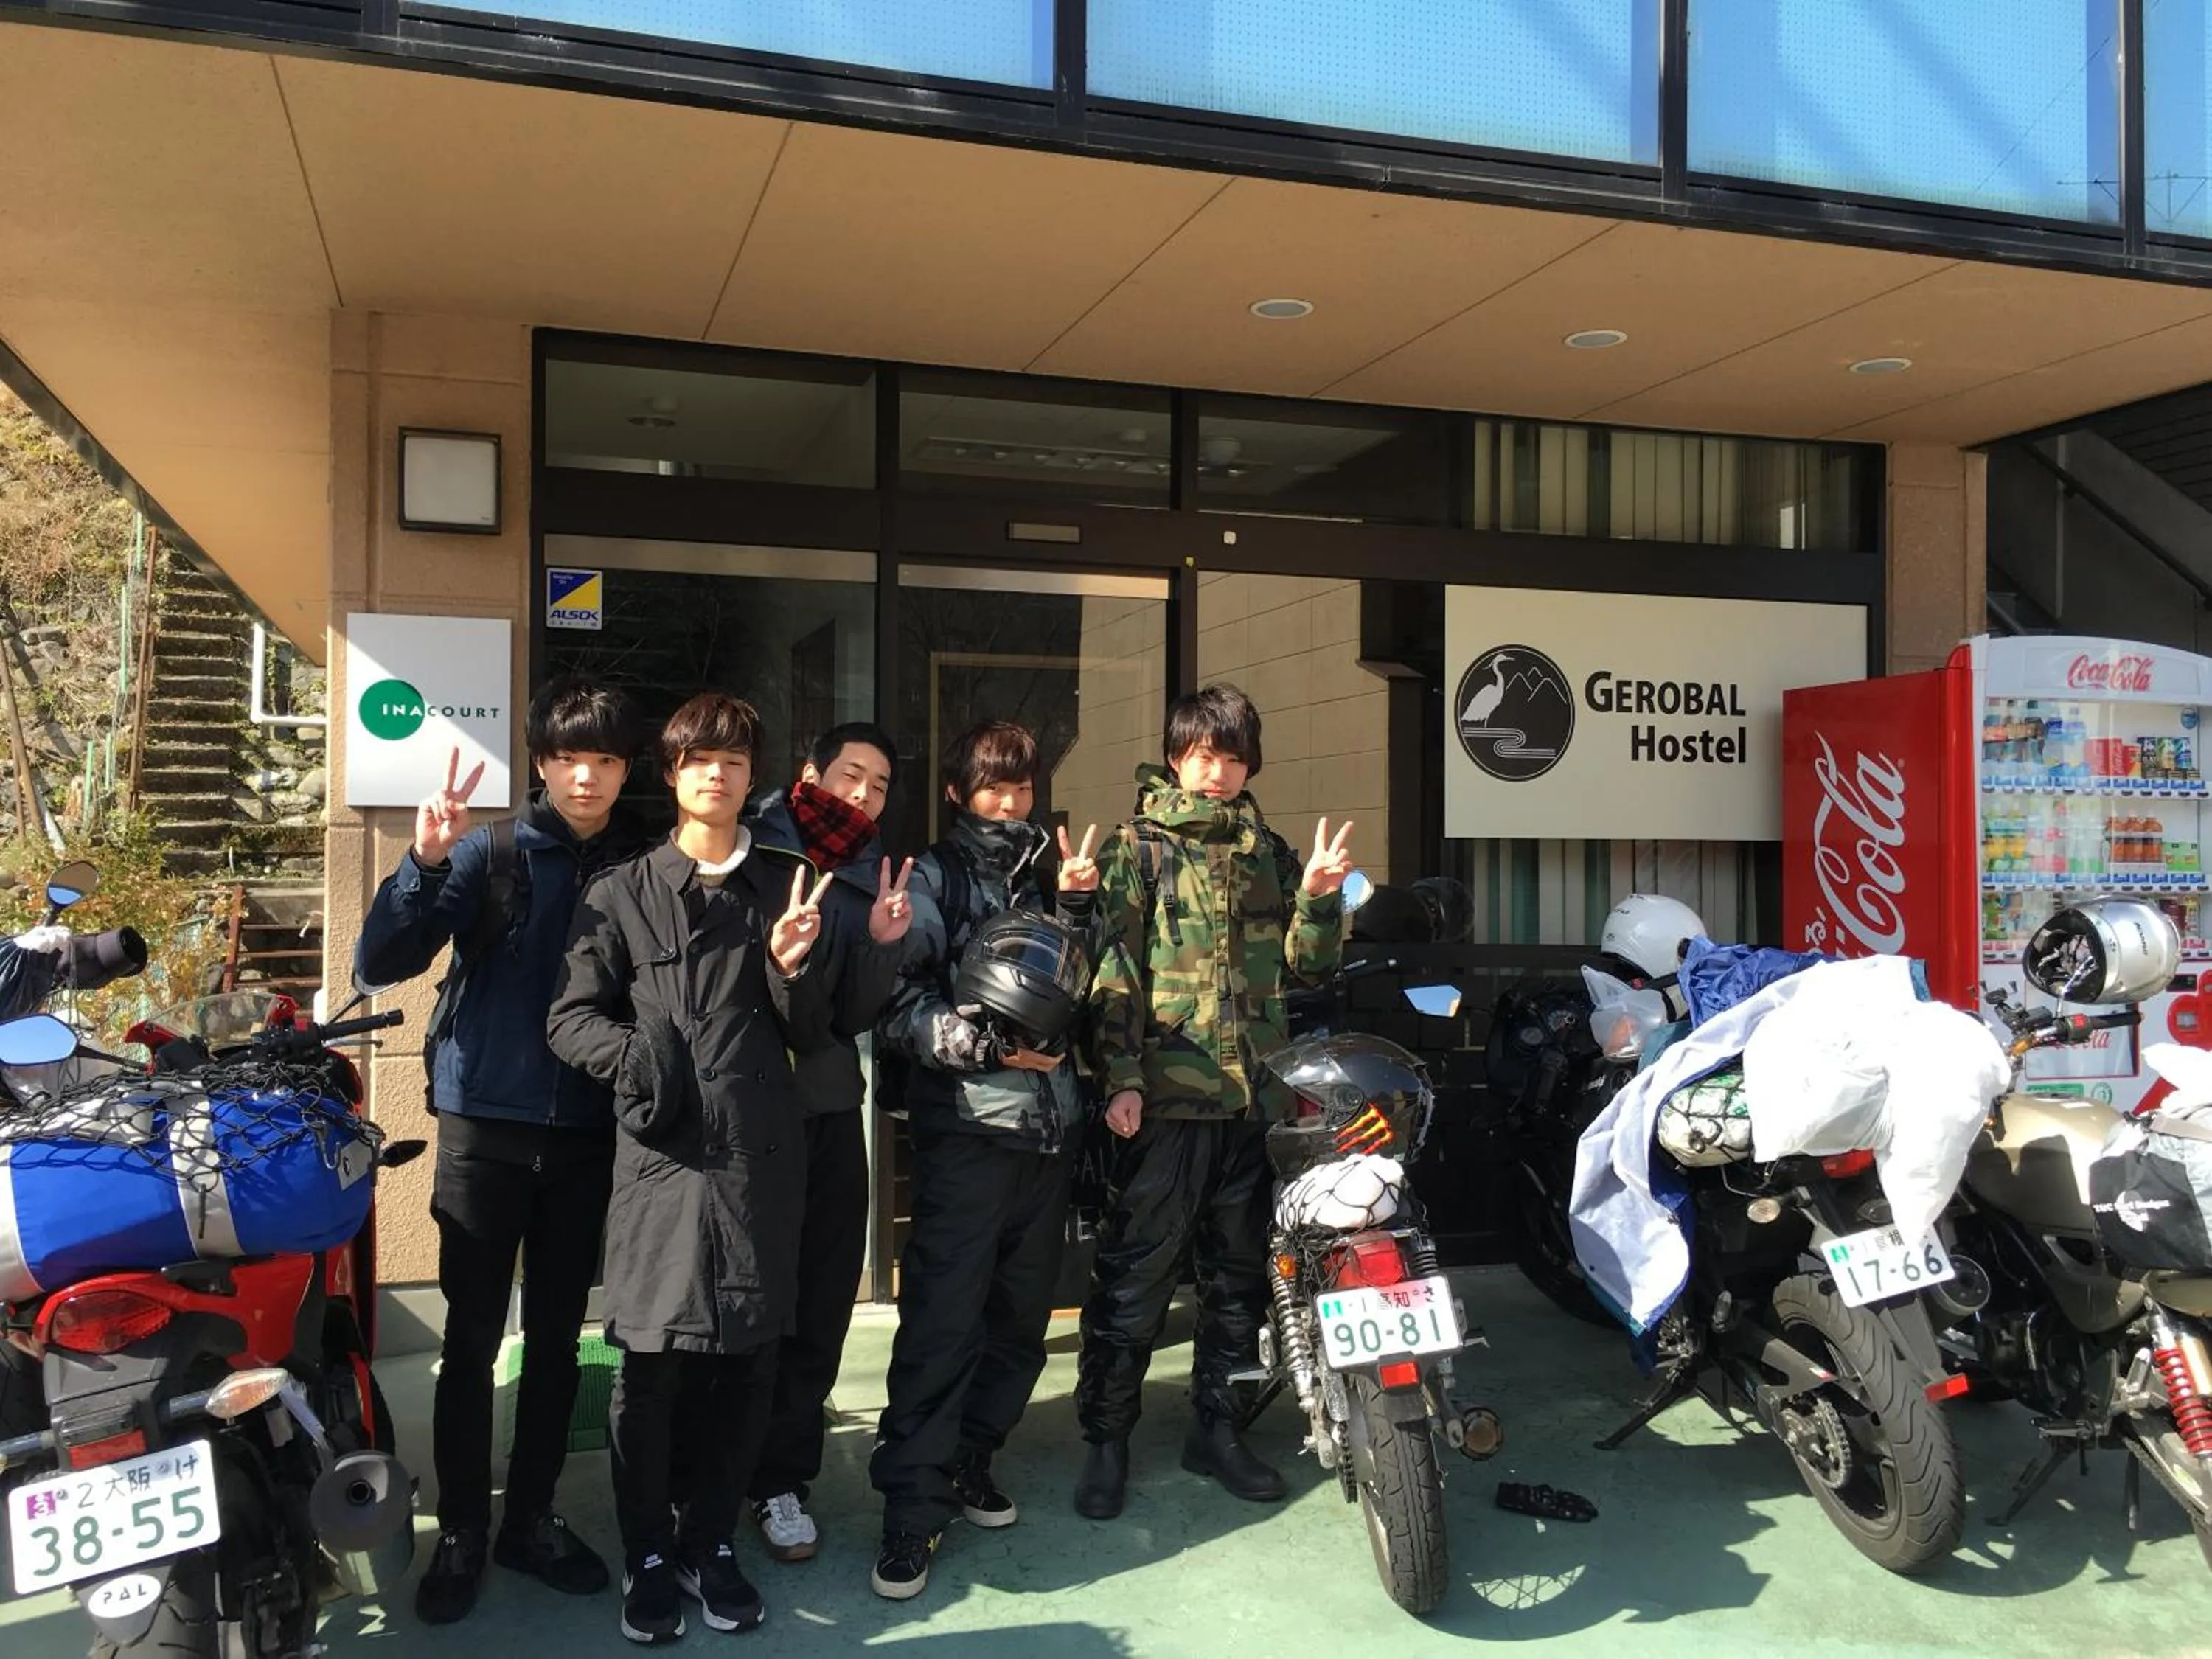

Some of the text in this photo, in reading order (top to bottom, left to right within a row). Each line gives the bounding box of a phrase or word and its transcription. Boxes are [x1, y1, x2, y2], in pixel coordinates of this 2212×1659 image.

[550, 609, 599, 621] ALSOK
[1585, 670, 1746, 717] GEROBAL
[1632, 725, 1746, 763] Hostel
[1847, 1244, 1943, 1298] 17-66
[1333, 1309, 1441, 1357] 90-81
[30, 1486, 204, 1577] 38-55
